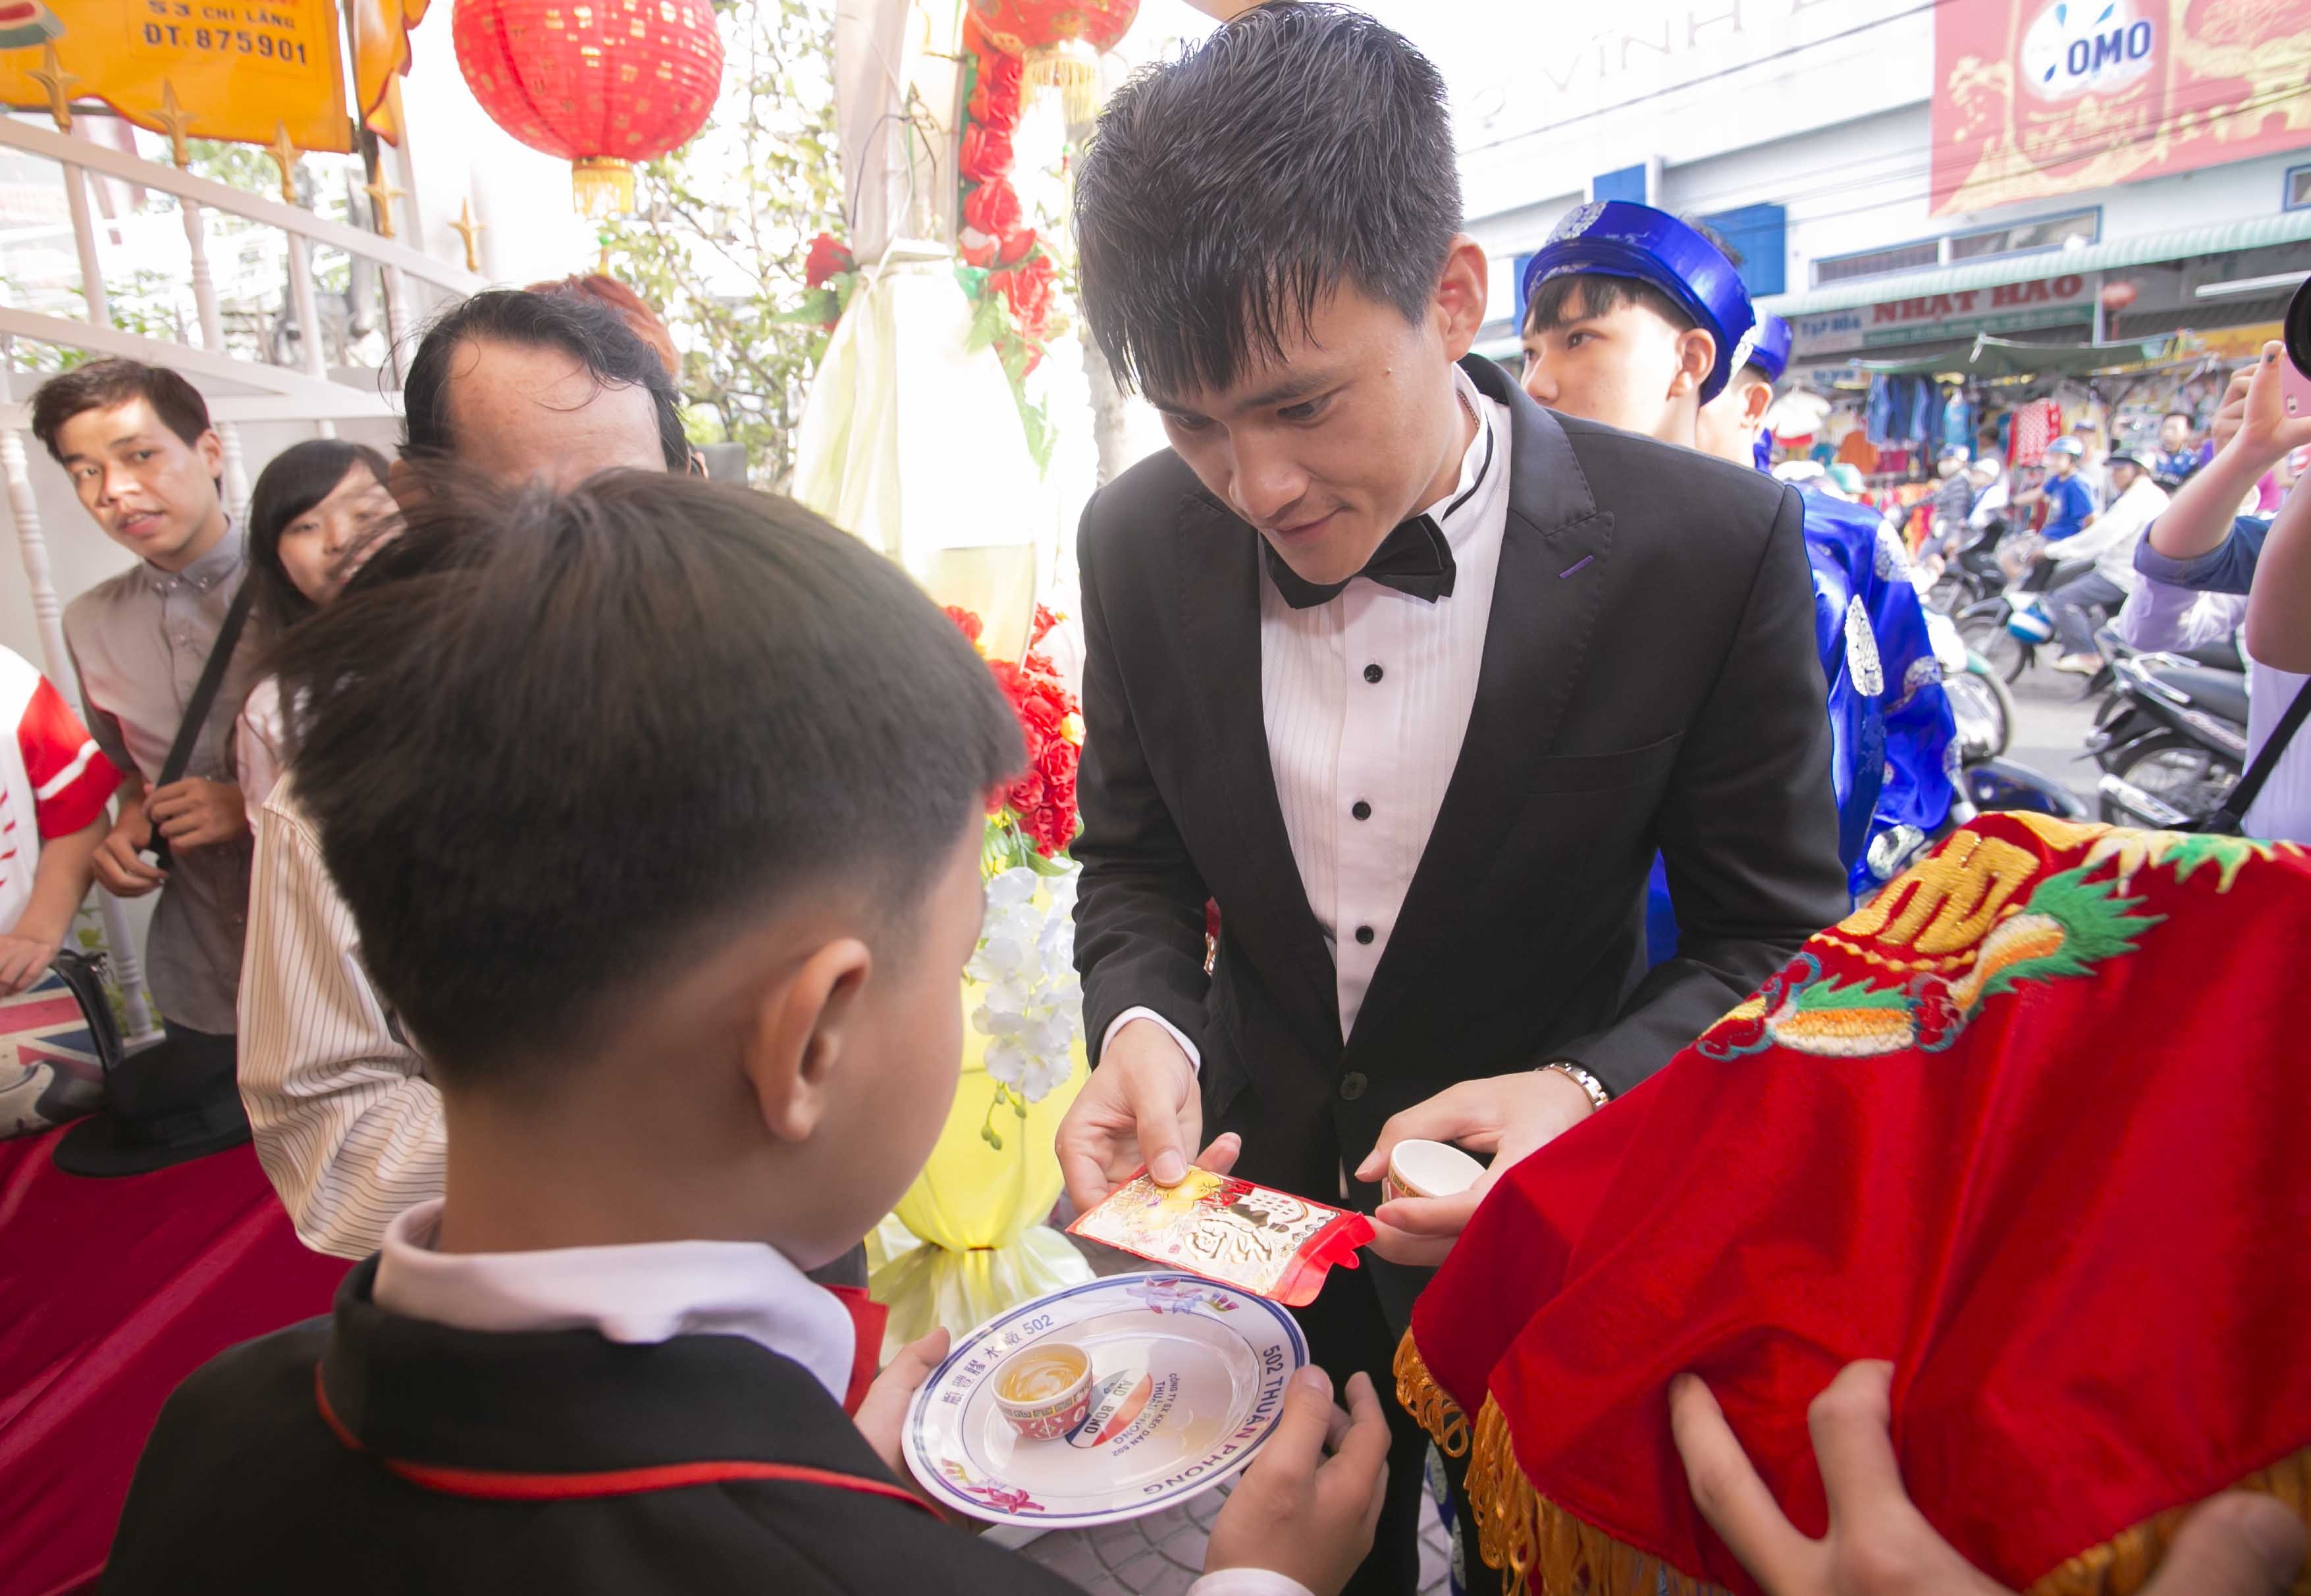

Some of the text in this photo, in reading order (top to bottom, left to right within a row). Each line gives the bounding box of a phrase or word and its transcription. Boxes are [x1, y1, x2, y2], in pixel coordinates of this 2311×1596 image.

[202, 7, 235, 21] CHI
[2067, 20, 2152, 76] OMO
[1023, 1314, 1053, 1335] 502
[1263, 1344, 1284, 1375] 502
[1167, 1393, 1176, 1403] TY
[1084, 1404, 1115, 1435] BOND
[1142, 1443, 1239, 1496] PHONG
